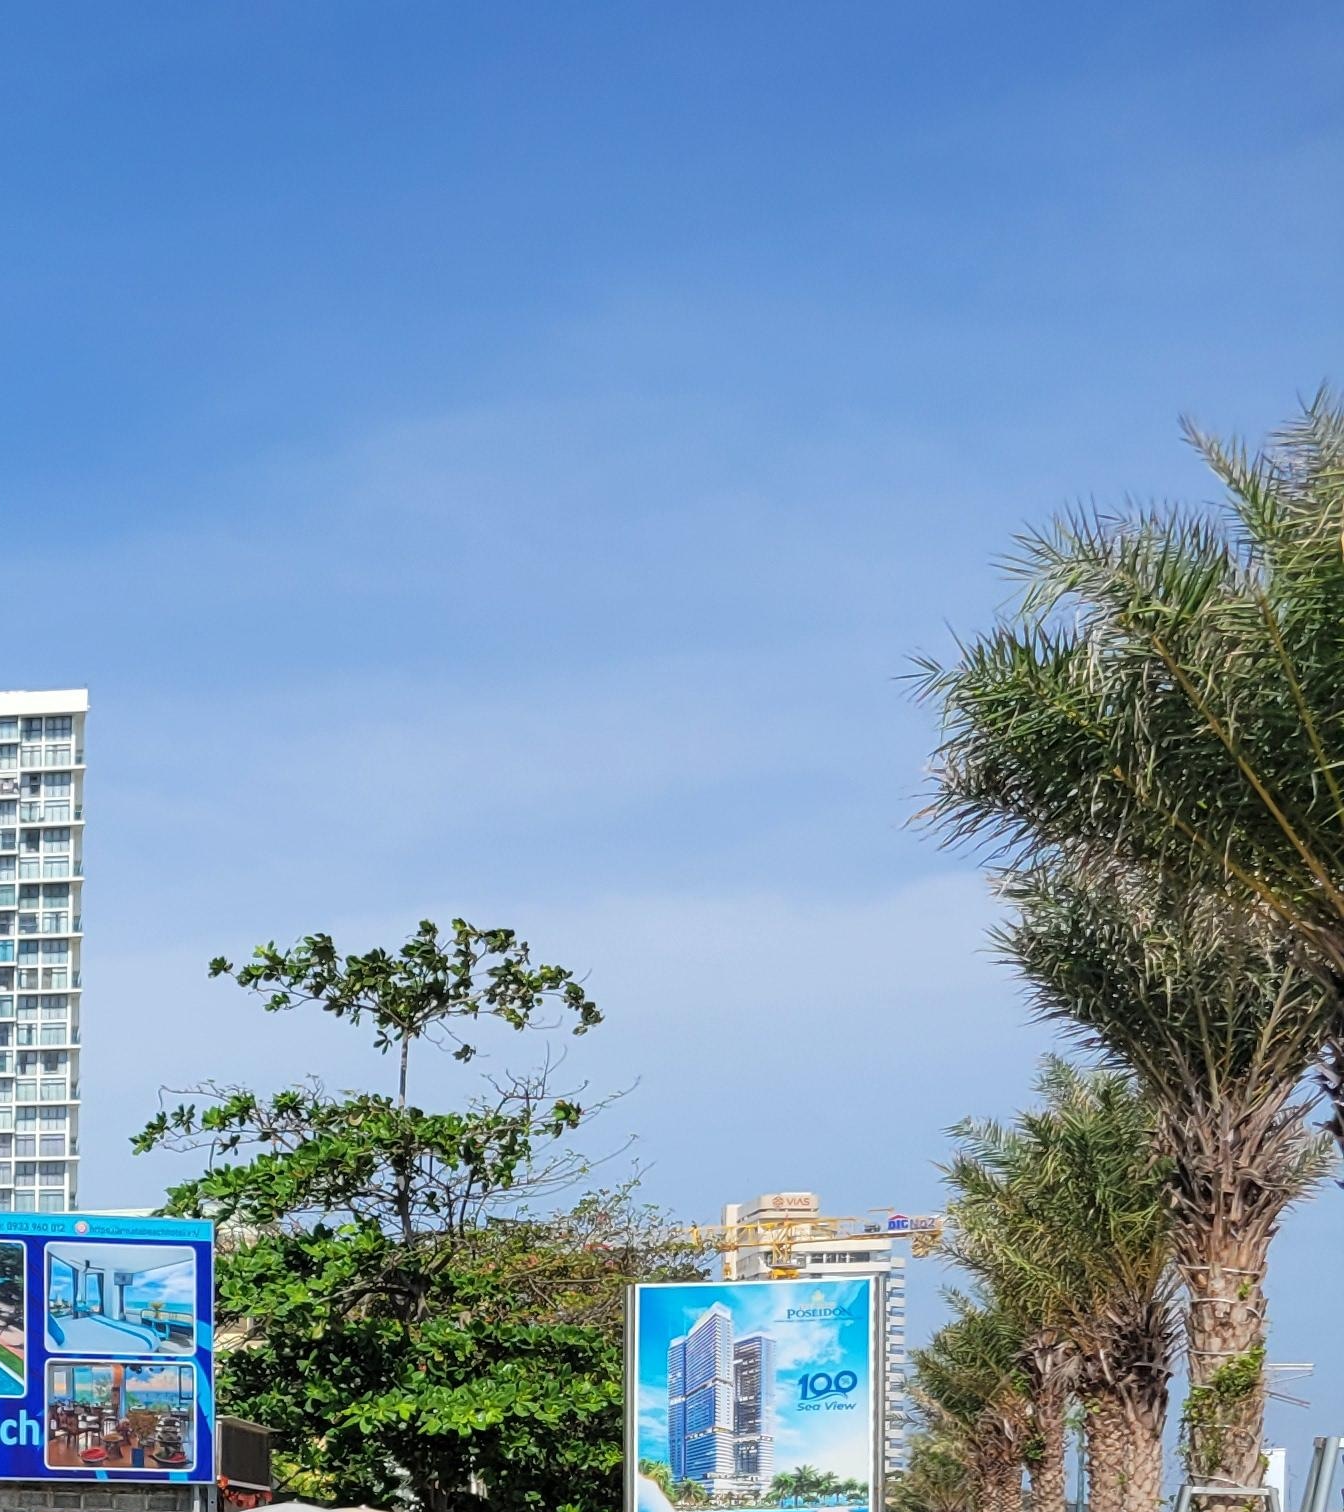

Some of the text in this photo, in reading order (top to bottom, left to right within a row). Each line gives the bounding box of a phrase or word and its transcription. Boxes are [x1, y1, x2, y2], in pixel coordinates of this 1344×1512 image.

[888, 1219, 909, 1231] DIC
[796, 1401, 857, 1412] Sea View
